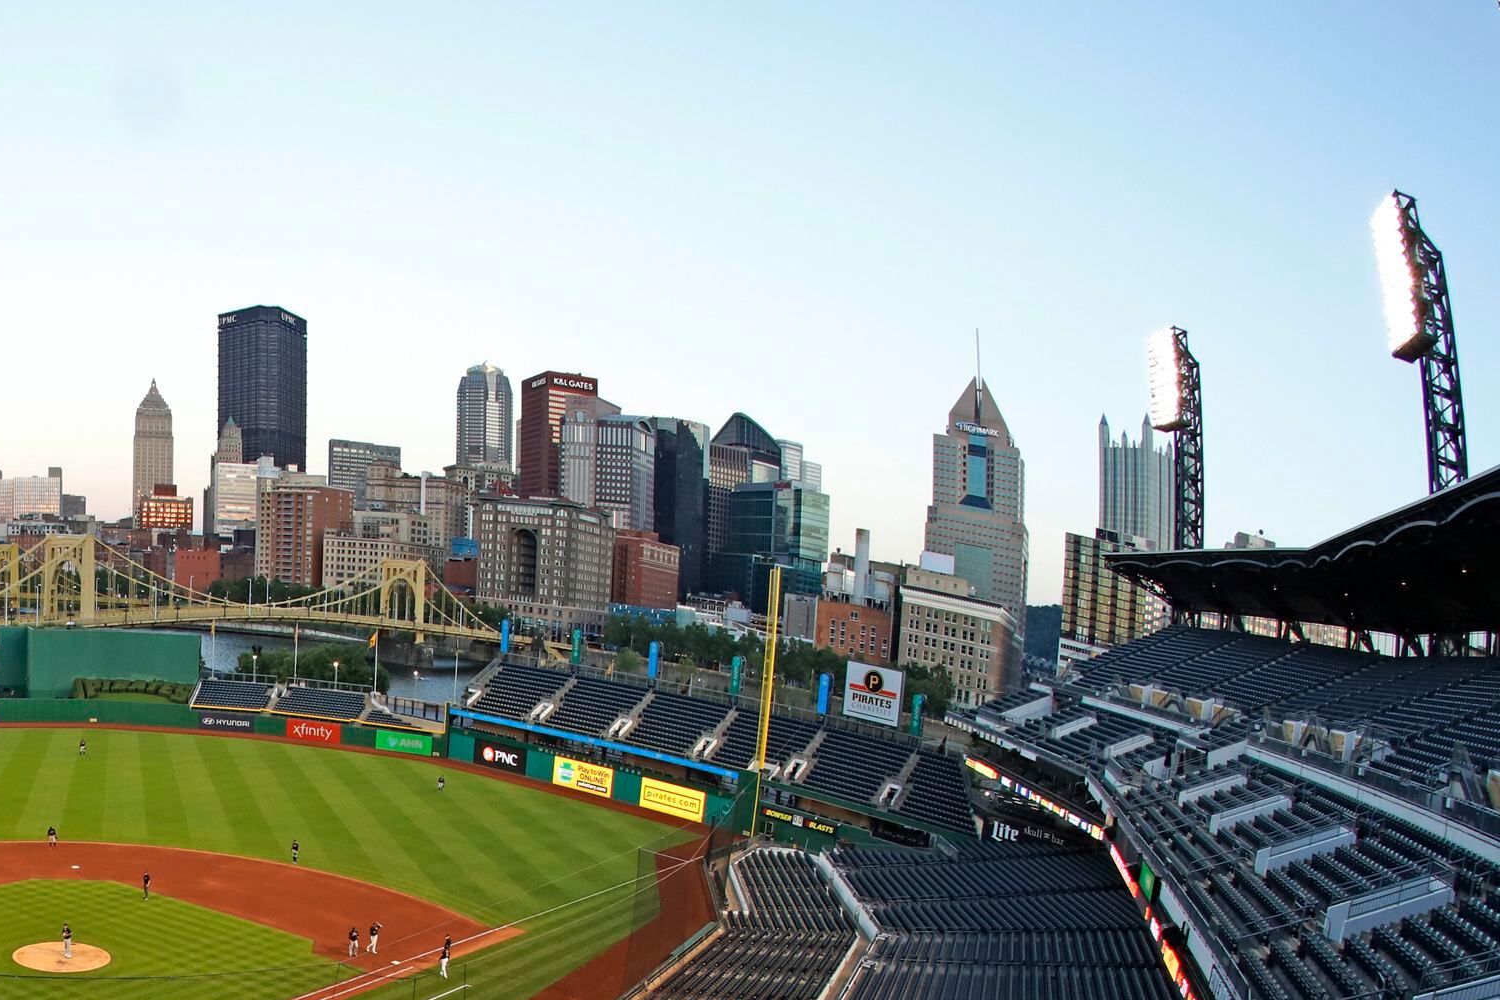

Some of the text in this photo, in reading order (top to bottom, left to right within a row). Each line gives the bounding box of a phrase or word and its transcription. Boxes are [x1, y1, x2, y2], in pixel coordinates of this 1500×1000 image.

[281, 312, 296, 326] UPMC
[553, 377, 594, 391] K&L GATES
[960, 424, 999, 437] HIGHMARK
[869, 675, 878, 689] P
[851, 693, 892, 709] PIRATES
[851, 702, 891, 716] CHARITIES
[215, 719, 250, 728] HYUNDAI
[293, 722, 333, 741] xfinity
[399, 737, 423, 749] AHN
[494, 750, 518, 767] PNC
[577, 765, 590, 775] Play
[597, 769, 610, 778] Win
[579, 773, 607, 785] ONLINE!
[646, 790, 697, 809] pirates.com
[765, 809, 793, 822] BOWSER
[808, 821, 834, 834] BLASTS
[991, 820, 1064, 846] Lite skull bar
